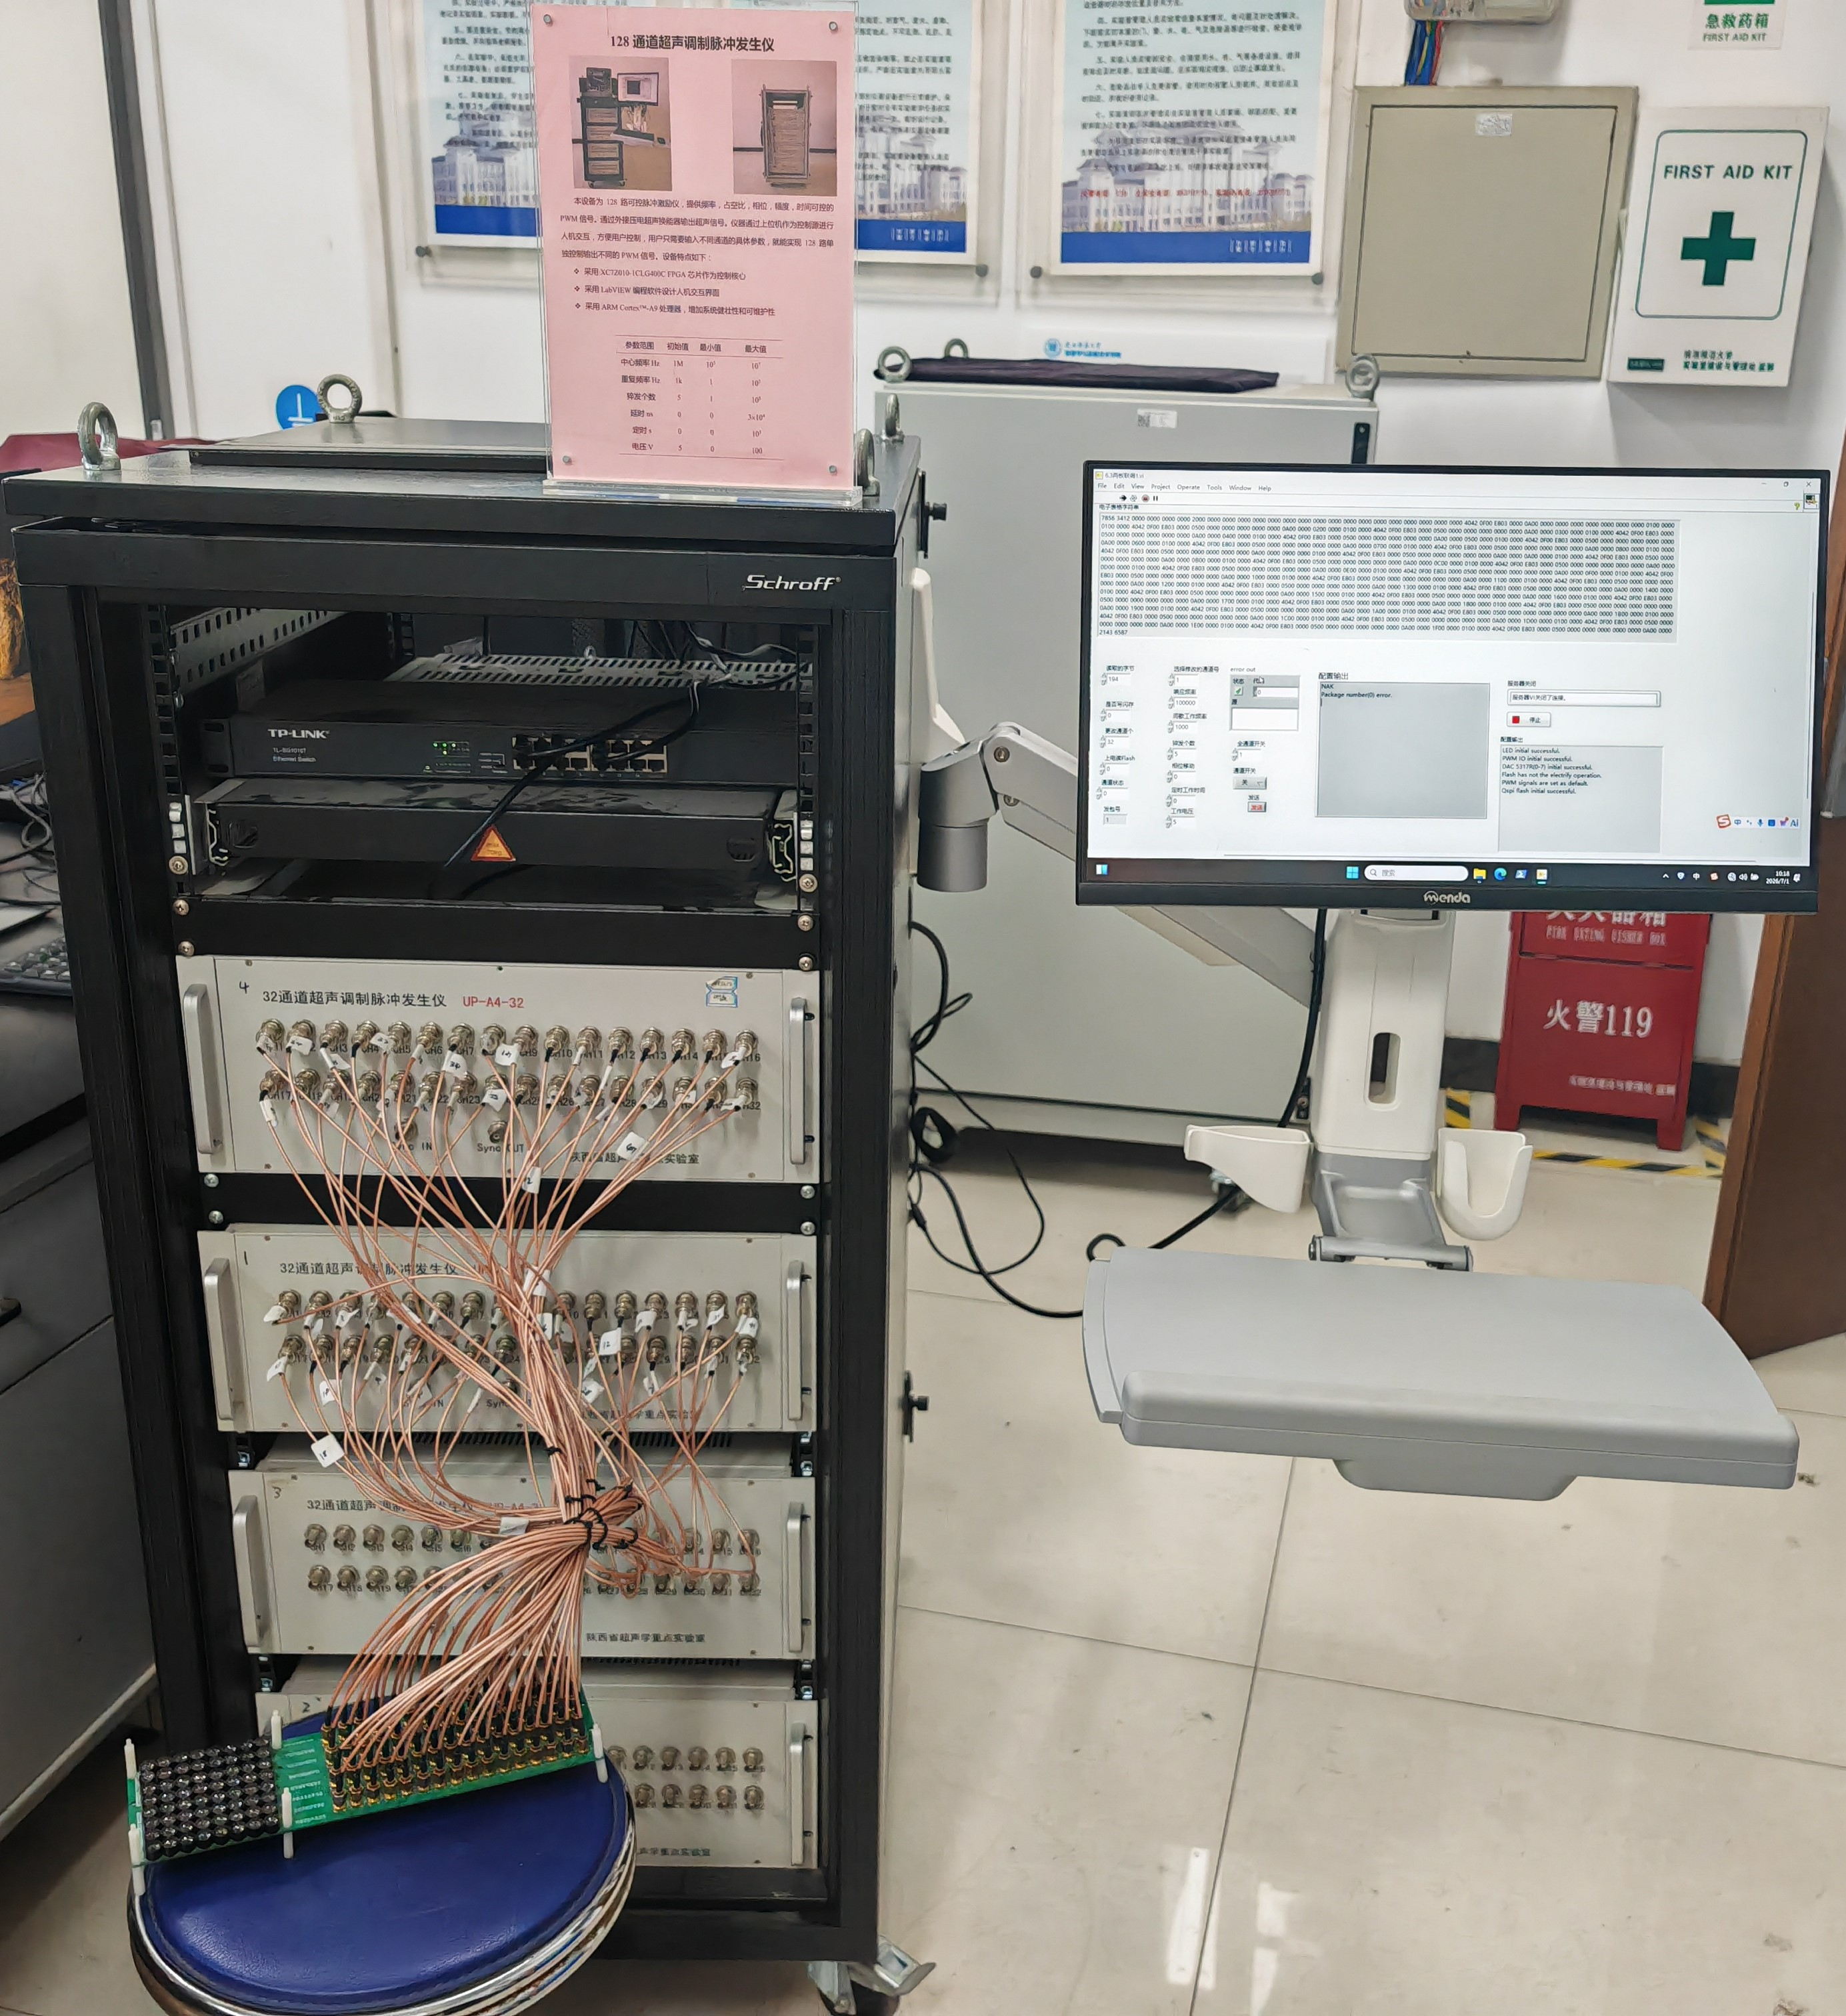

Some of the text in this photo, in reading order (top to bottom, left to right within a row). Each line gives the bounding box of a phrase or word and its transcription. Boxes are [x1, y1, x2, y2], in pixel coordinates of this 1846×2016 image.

[1703, 33, 1767, 41] FIRST AID KIT
[611, 35, 775, 52] 128 通道超声调制脉冲发生仪
[1664, 165, 1793, 180] FIRST AID KIT
[584, 268, 599, 276] 采用
[585, 285, 599, 293] 采用
[601, 286, 631, 294] LabVIEW
[585, 302, 600, 311] 采用
[625, 341, 767, 353] 参数范围 初始值 最小值 最大值
[632, 443, 647, 451] 电压
[1318, 672, 1349, 680] 配置输出
[267, 729, 327, 739] TP-LINK
[239, 981, 249, 993] 4
[263, 991, 524, 1009] 32通道超声调制脉冲发生仪 UP-A4-32
[1543, 999, 1653, 1039] 火警119
[272, 1486, 282, 1499] 3
[302, 1701, 311, 1713] 2
